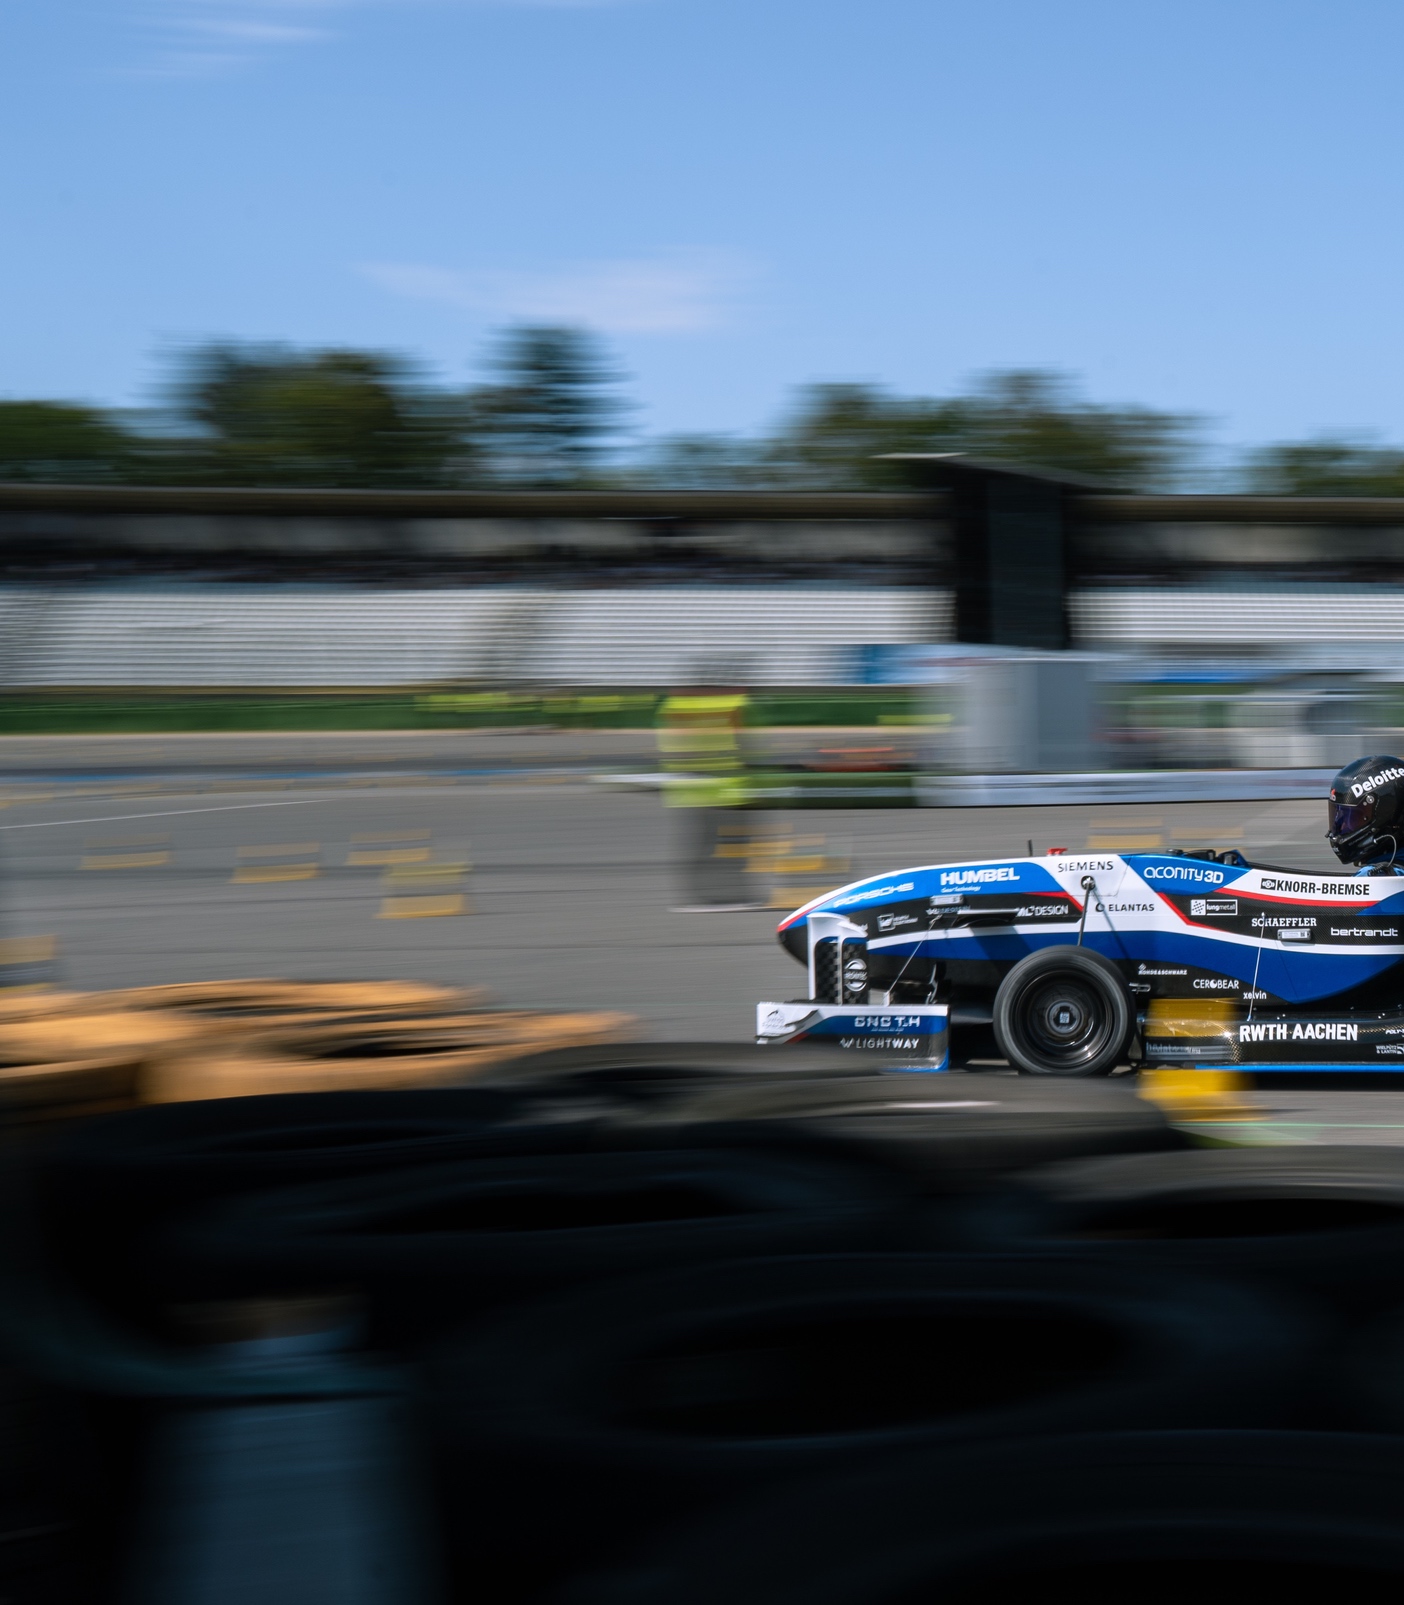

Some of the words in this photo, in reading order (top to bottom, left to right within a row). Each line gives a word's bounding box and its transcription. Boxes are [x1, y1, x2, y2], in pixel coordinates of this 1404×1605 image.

[1058, 860, 1114, 873] SIEMENS
[940, 867, 1020, 885] HUMBEL
[1276, 880, 1370, 896] KNORR-BREMSE
[833, 881, 915, 908] PORSCHE
[1108, 903, 1155, 912] ELANTAS
[1251, 917, 1317, 927] SCHAEFFLER
[1330, 927, 1398, 938] bertrandt
[1243, 990, 1267, 999] xelvin
[1239, 1023, 1288, 1043] RWTH
[1291, 1023, 1358, 1041] AACHEN
[856, 1037, 920, 1049] LIGHTWAY
